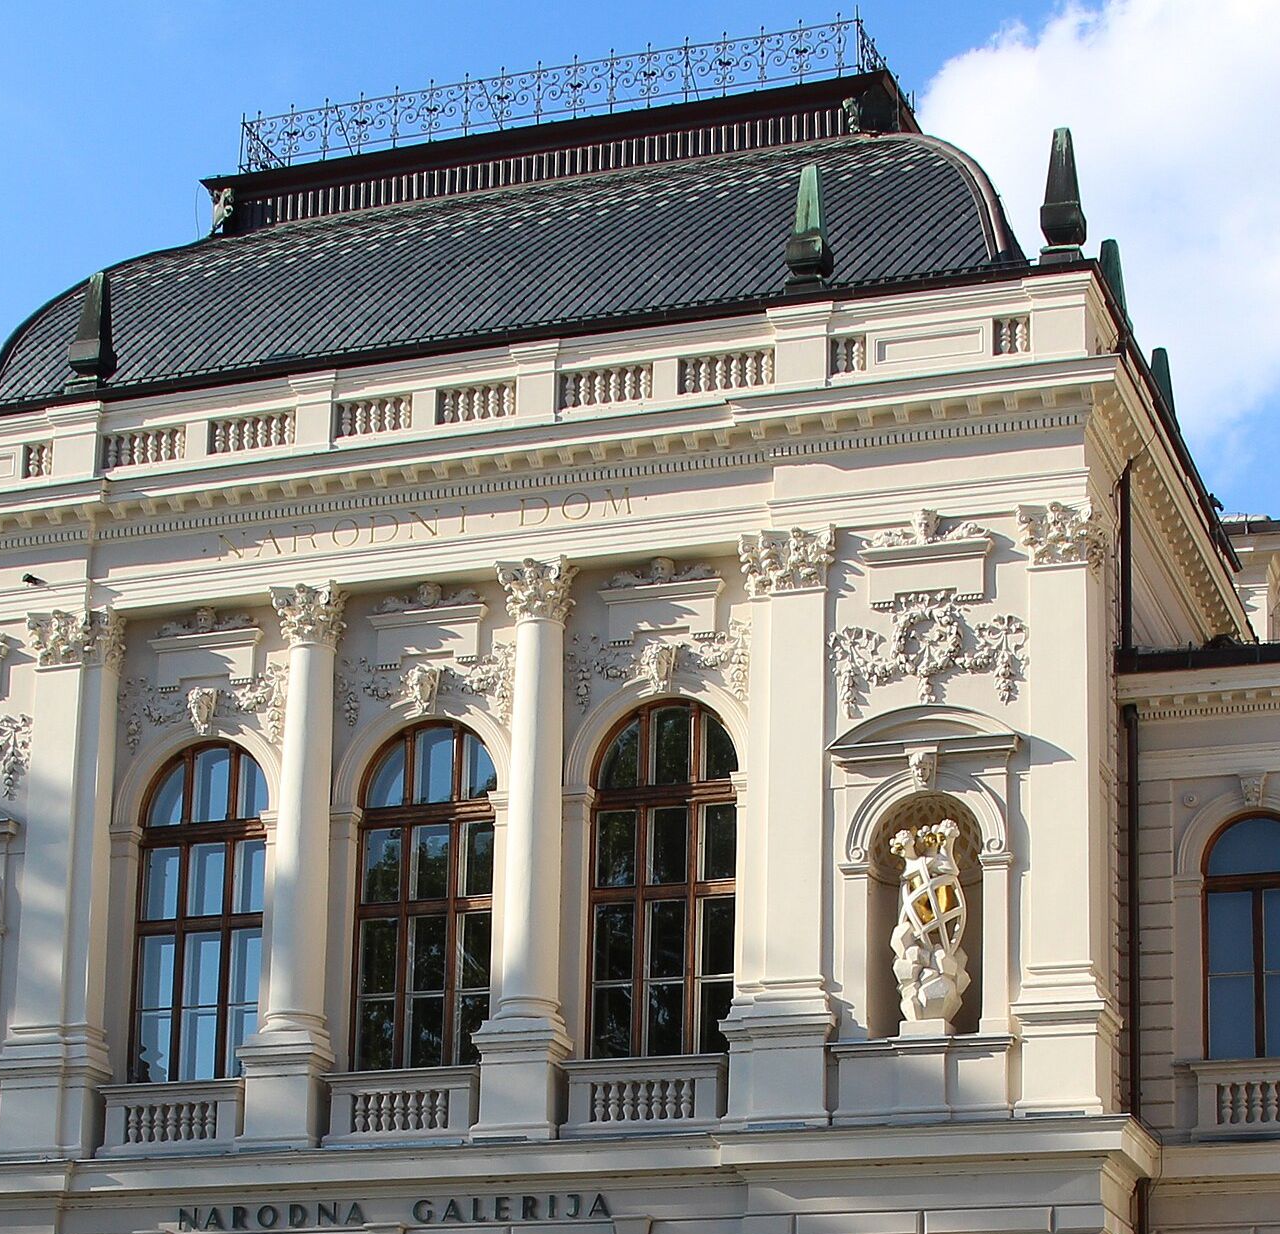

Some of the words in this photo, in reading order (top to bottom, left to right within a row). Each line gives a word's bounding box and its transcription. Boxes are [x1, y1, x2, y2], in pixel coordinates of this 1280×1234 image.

[217, 504, 467, 562] NARODNI
[519, 486, 633, 527] DOM
[178, 1201, 368, 1231] NARODNA
[412, 1192, 615, 1223] GALERIJA
